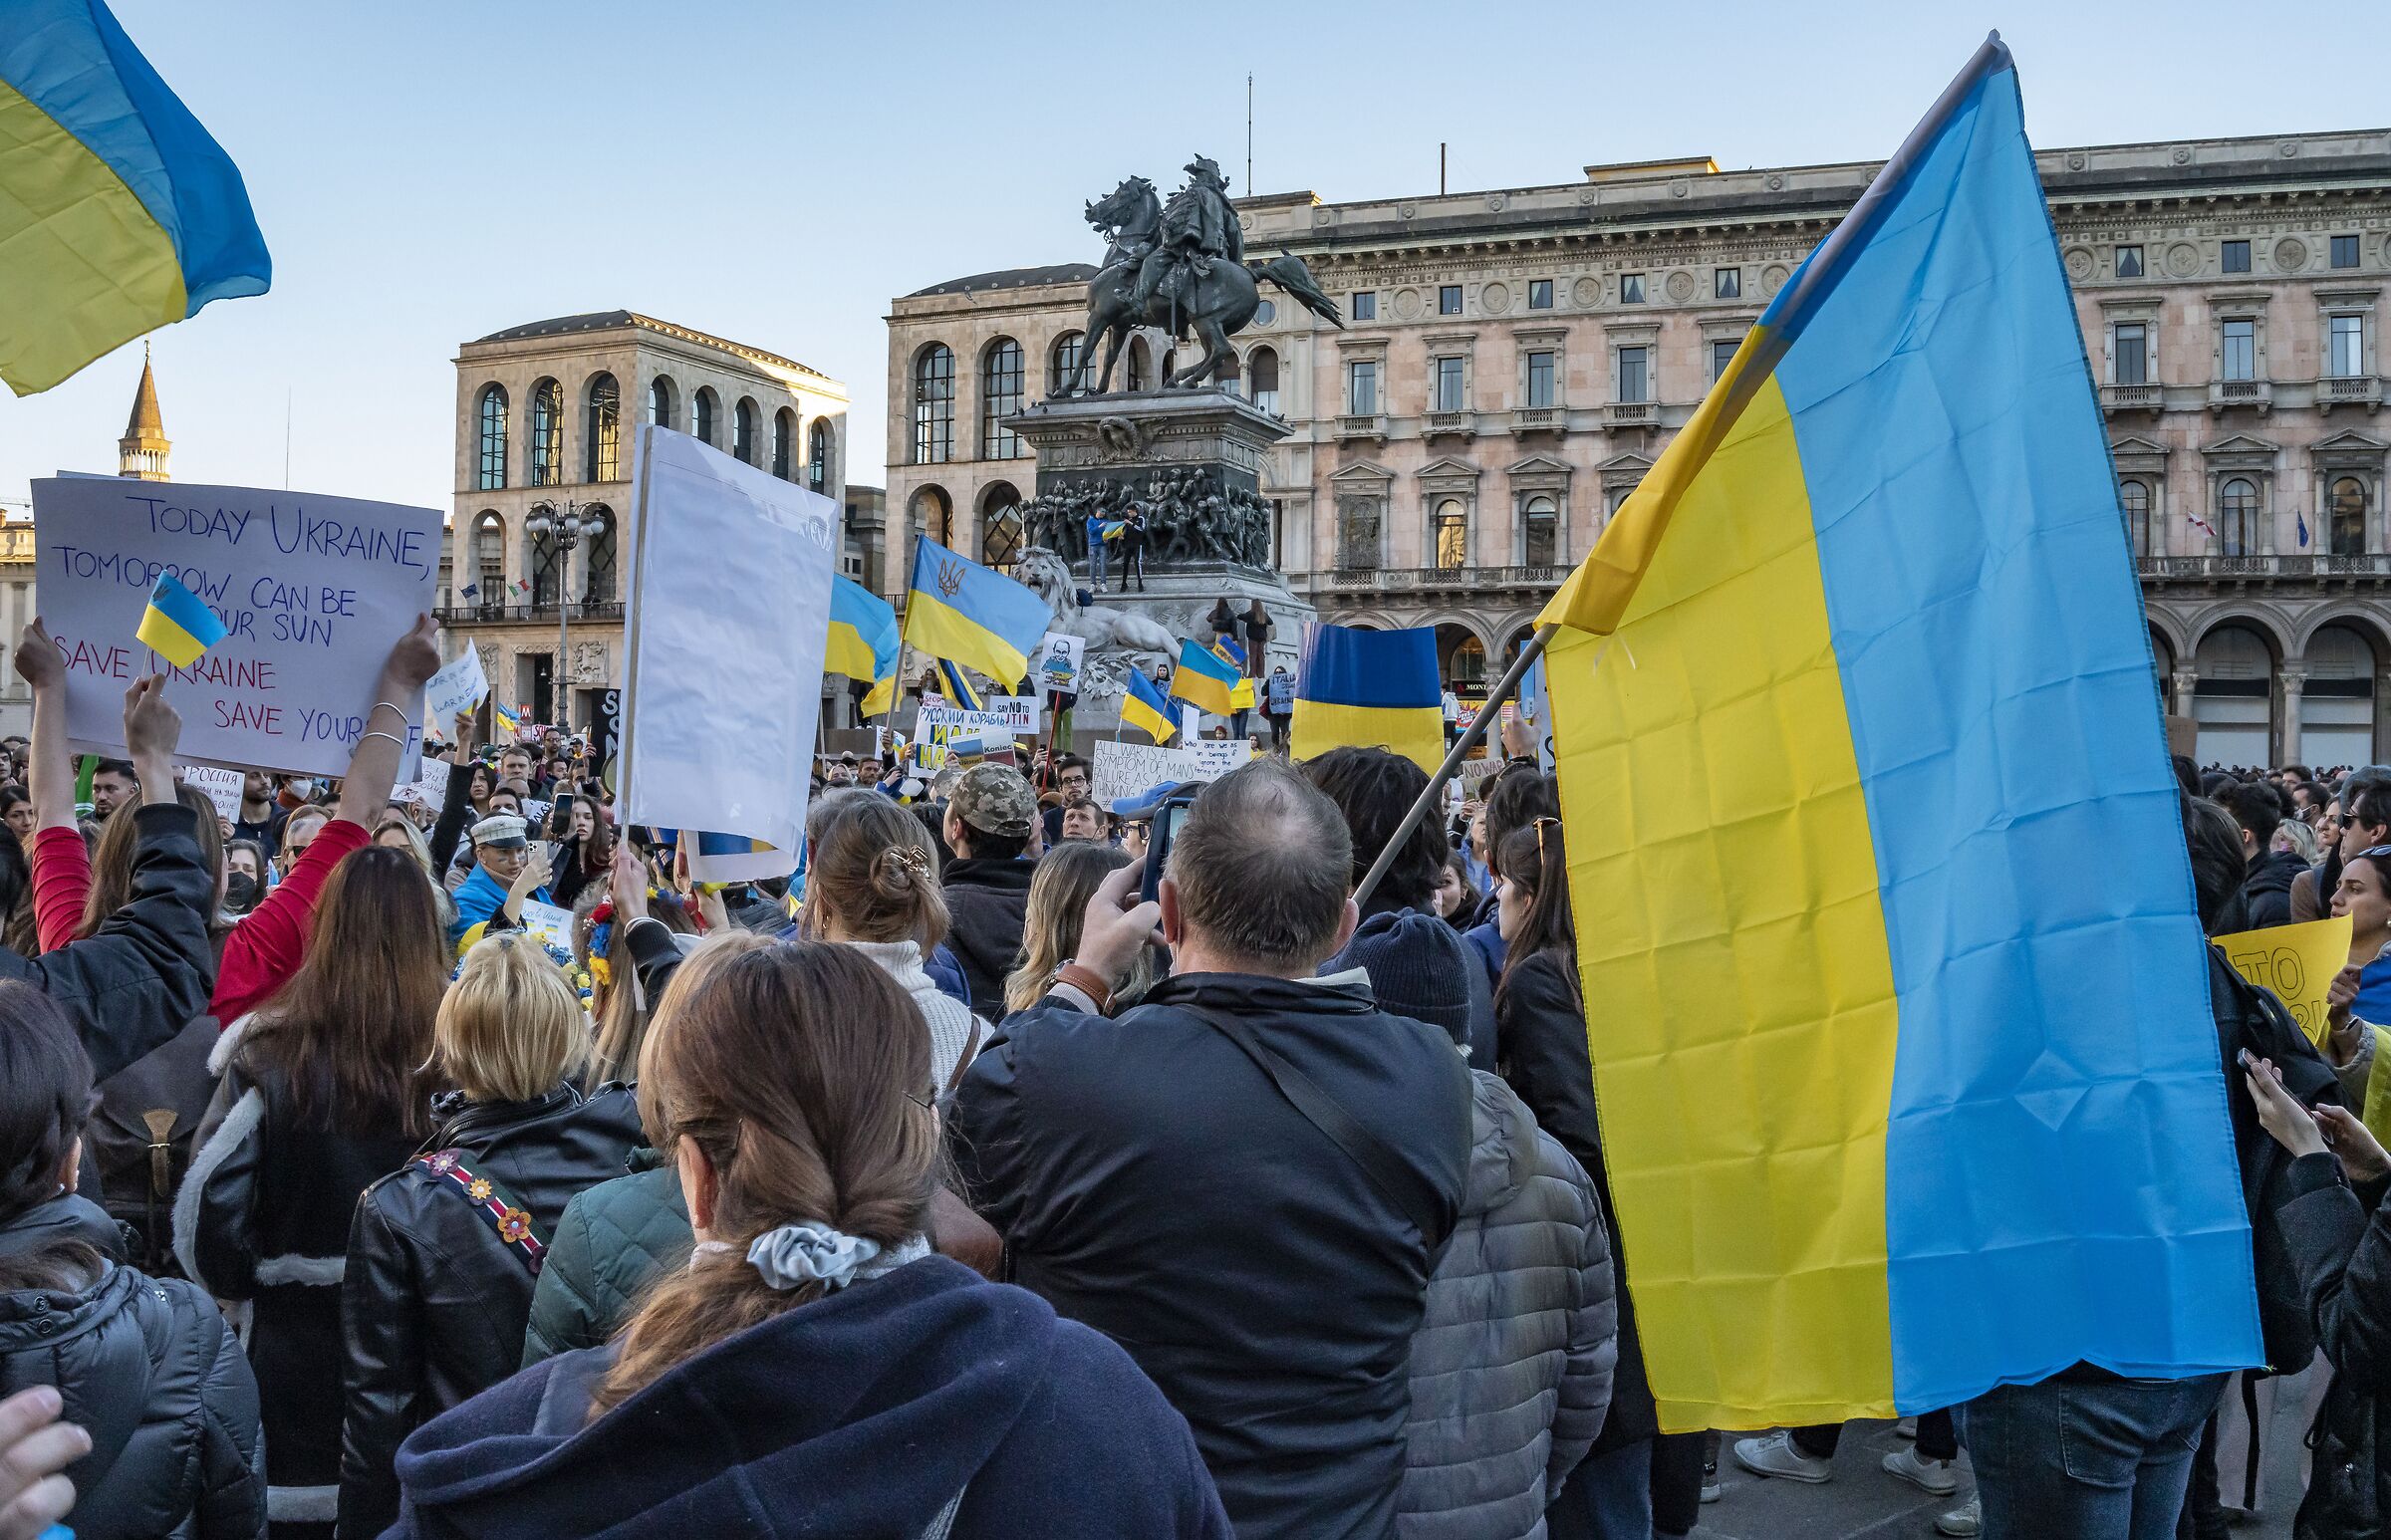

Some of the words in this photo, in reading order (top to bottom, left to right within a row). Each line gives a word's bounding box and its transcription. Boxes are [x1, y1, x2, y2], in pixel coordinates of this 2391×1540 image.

[125, 496, 251, 545] TODAY
[271, 505, 429, 582] UKRAINE,
[251, 577, 309, 612] CAN
[322, 587, 357, 618] BE
[273, 614, 332, 647] SUN
[997, 704, 1009, 713] SAY
[1008, 701, 1022, 713] NO
[214, 699, 284, 735] SAVE
[299, 708, 421, 755] YOURF
[983, 744, 1012, 754] Koniec
[1096, 741, 1118, 755] ALL
[1120, 746, 1144, 759] WAR
[1159, 749, 1169, 761] A
[1095, 754, 1146, 773] SYMPTOM
[1149, 760, 1165, 775] OF
[1463, 762, 1482, 779] NO
[1481, 759, 1502, 776] WAR
[189, 766, 238, 786] РОССИЯ
[1092, 767, 1131, 786] FAILURE
[1134, 772, 1152, 787] AS
[2233, 946, 2305, 1001] TO
